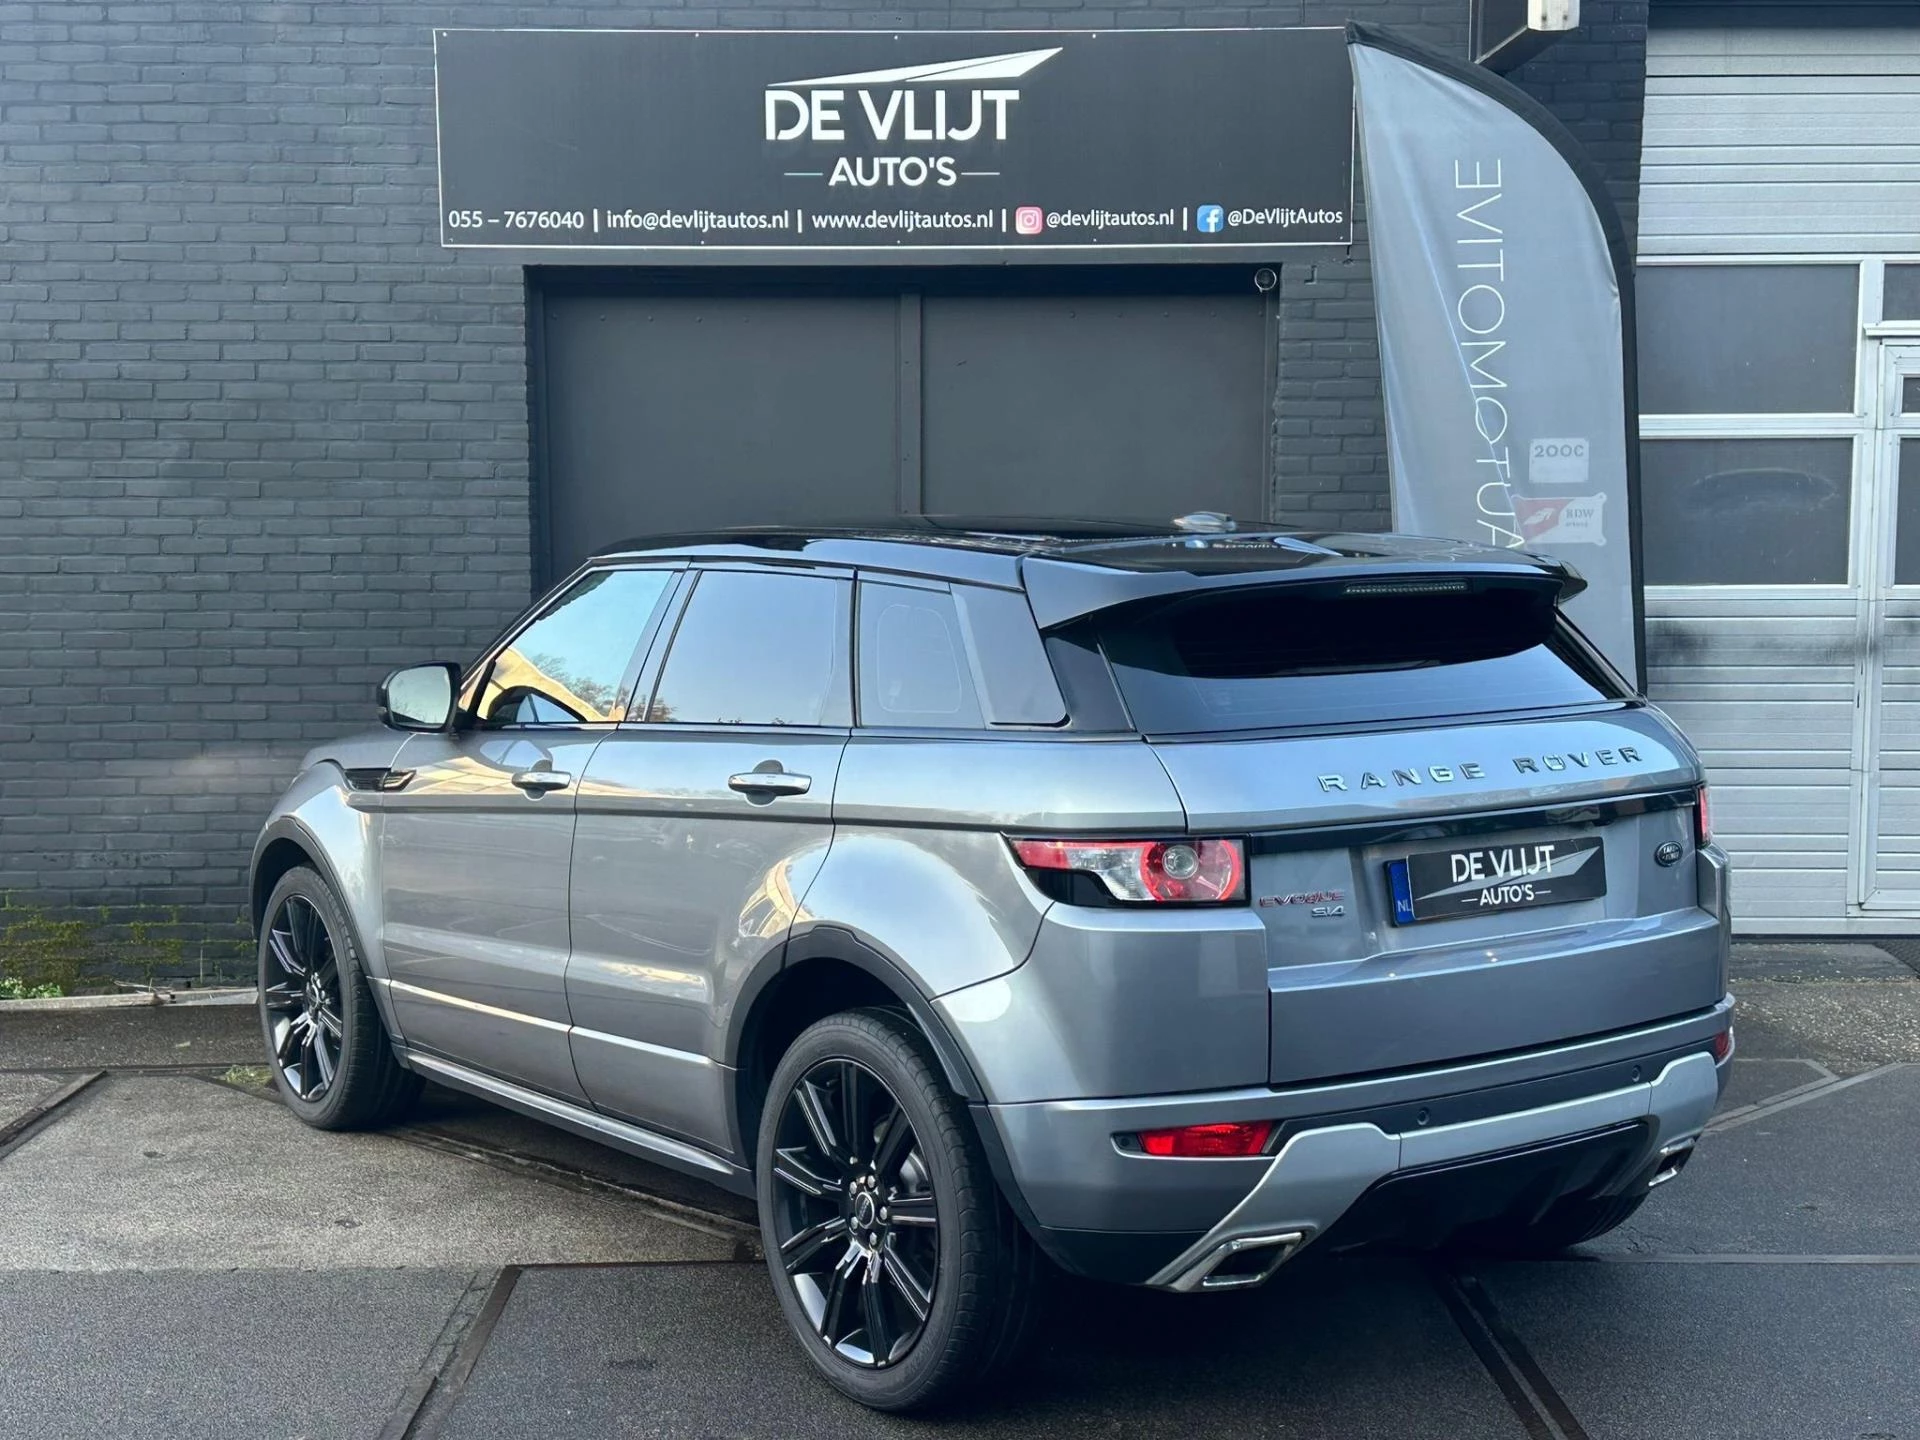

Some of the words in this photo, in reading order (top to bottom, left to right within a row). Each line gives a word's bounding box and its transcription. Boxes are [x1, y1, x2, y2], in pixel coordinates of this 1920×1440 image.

[764, 89, 846, 141] DE
[858, 89, 1020, 141] VLIJT
[828, 156, 957, 187] AUTO'S
[448, 210, 482, 229] 055
[504, 210, 584, 229] 7676040
[607, 209, 789, 233] info@devlijtautos.nl
[812, 209, 993, 233] www.devlijtautos.nl
[1046, 208, 1174, 231] @devlijtautos.nl
[1227, 207, 1343, 227] @DeVlijtAutos
[1316, 761, 1486, 793] RANGE
[1512, 745, 1643, 774] ROVER
[1450, 851, 1484, 883] DE
[1487, 844, 1556, 879] VLIJT
[1396, 899, 1412, 913] NL
[1479, 883, 1535, 907] AUTO'S
